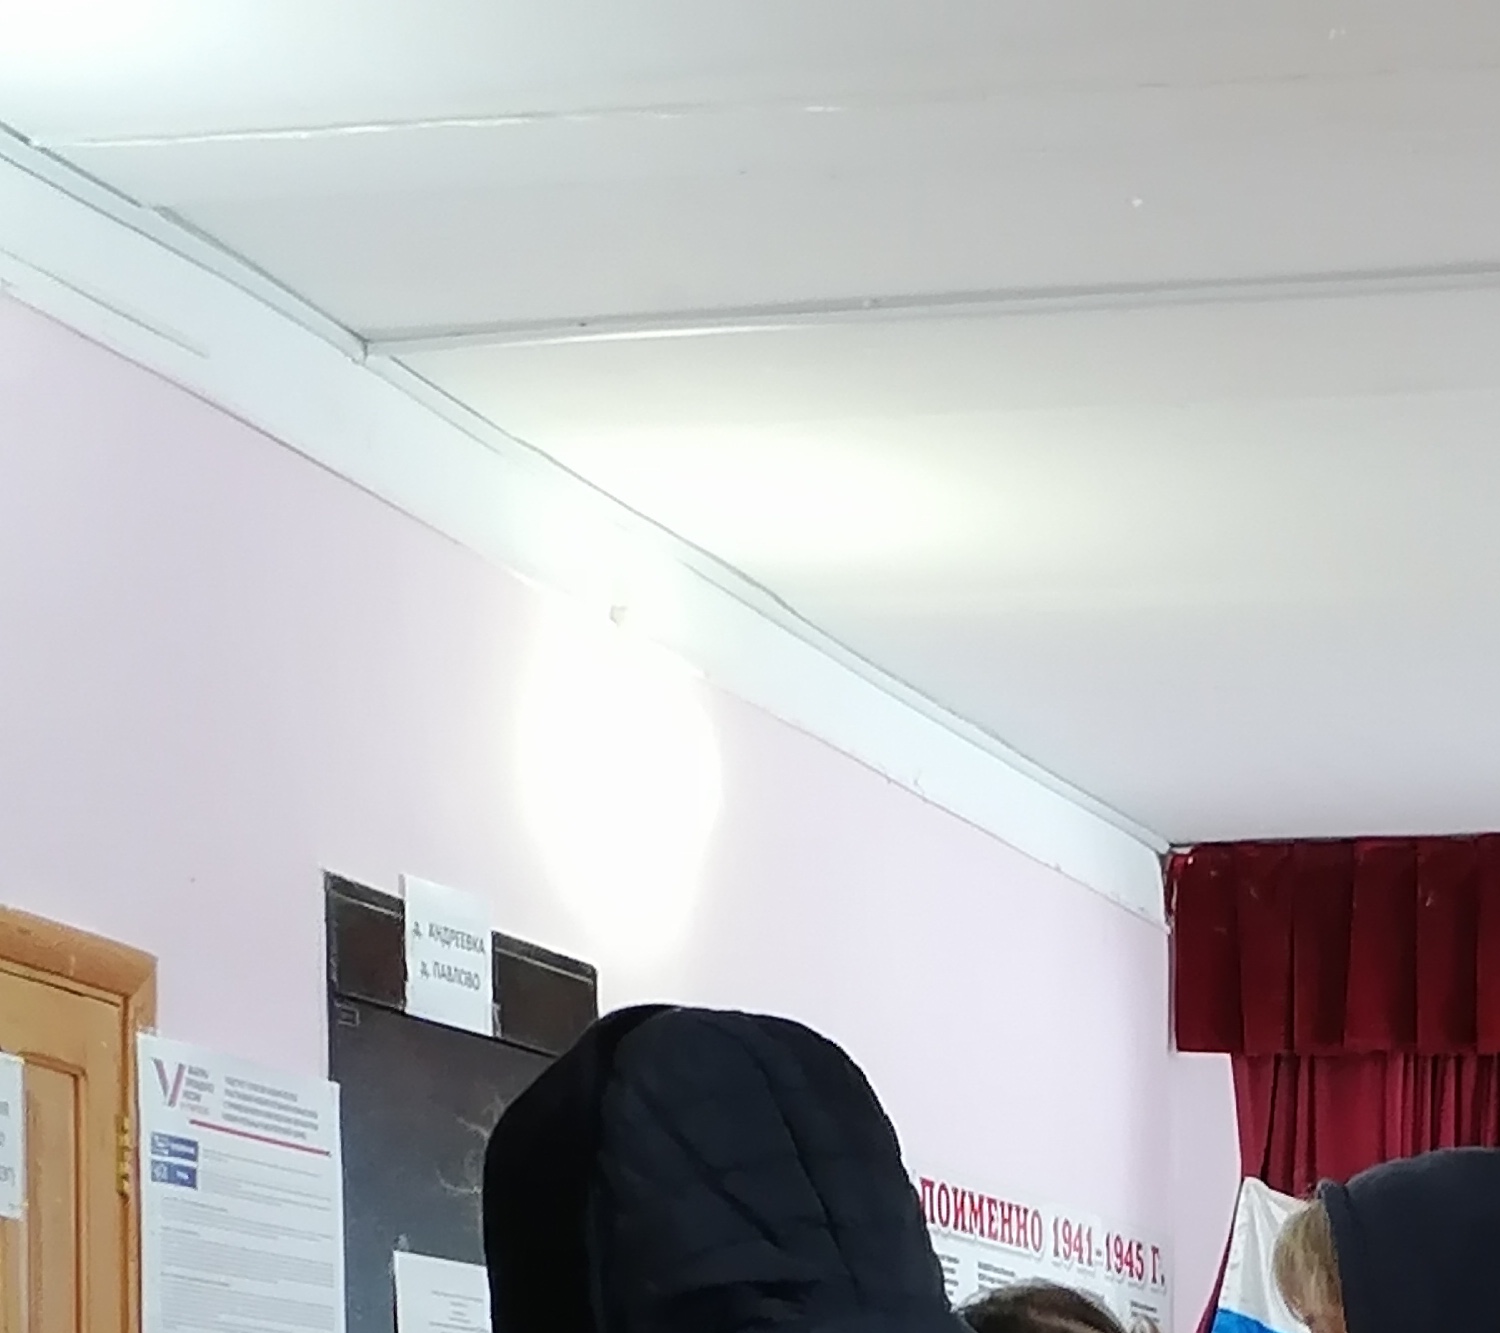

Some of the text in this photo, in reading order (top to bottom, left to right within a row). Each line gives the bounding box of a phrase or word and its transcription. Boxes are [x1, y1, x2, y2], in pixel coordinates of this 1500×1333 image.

[428, 923, 486, 955] АНДРЕЕВКА
[433, 961, 481, 991] ПАВЛОВО
[1052, 1216, 1145, 1282] 1941-1945
